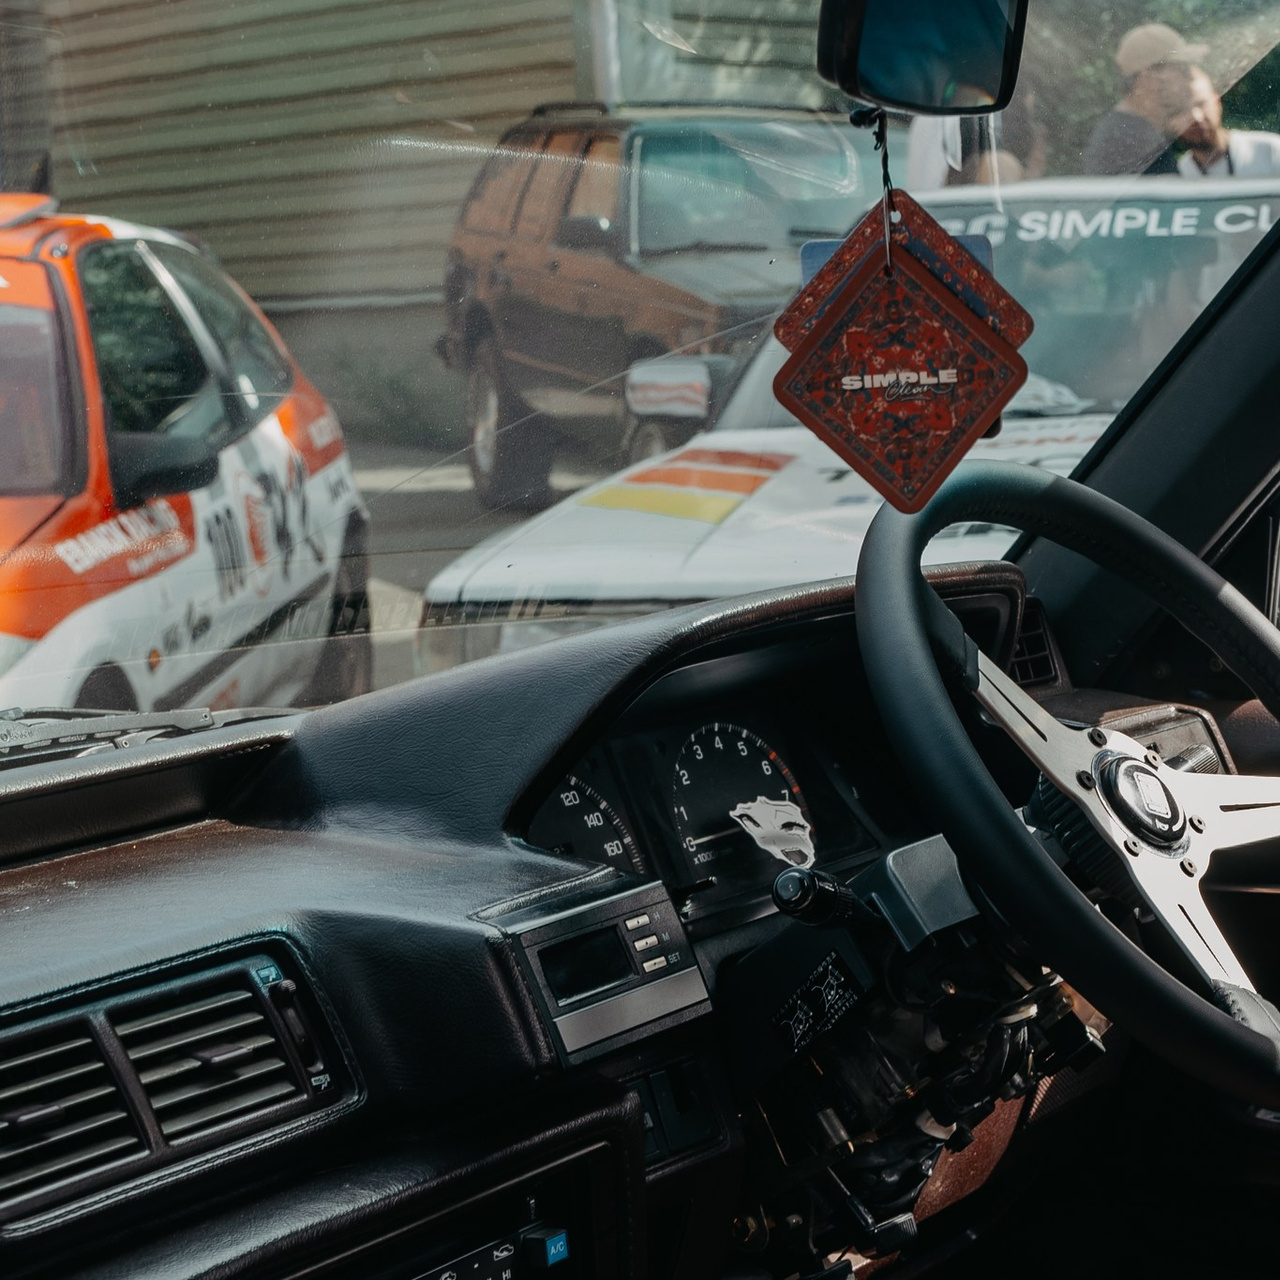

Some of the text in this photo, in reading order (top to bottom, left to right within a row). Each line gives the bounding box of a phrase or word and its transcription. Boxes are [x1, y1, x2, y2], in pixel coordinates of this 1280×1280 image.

[1016, 207, 1200, 242] SIMPLE
[841, 369, 959, 391] SIMPLE
[884, 379, 953, 402] Clean
[714, 736, 723, 751] 4
[737, 741, 748, 756] 5
[693, 745, 703, 760] 3
[761, 761, 772, 775] 6
[679, 770, 690, 785] 2
[560, 790, 580, 808] 120
[584, 812, 604, 830] 140
[679, 806, 688, 821] 1
[603, 840, 623, 858] 160
[653, 911, 661, 921] H
[661, 932, 671, 942] M
[668, 951, 680, 964] SET
[550, 1240, 566, 1257] A/C
